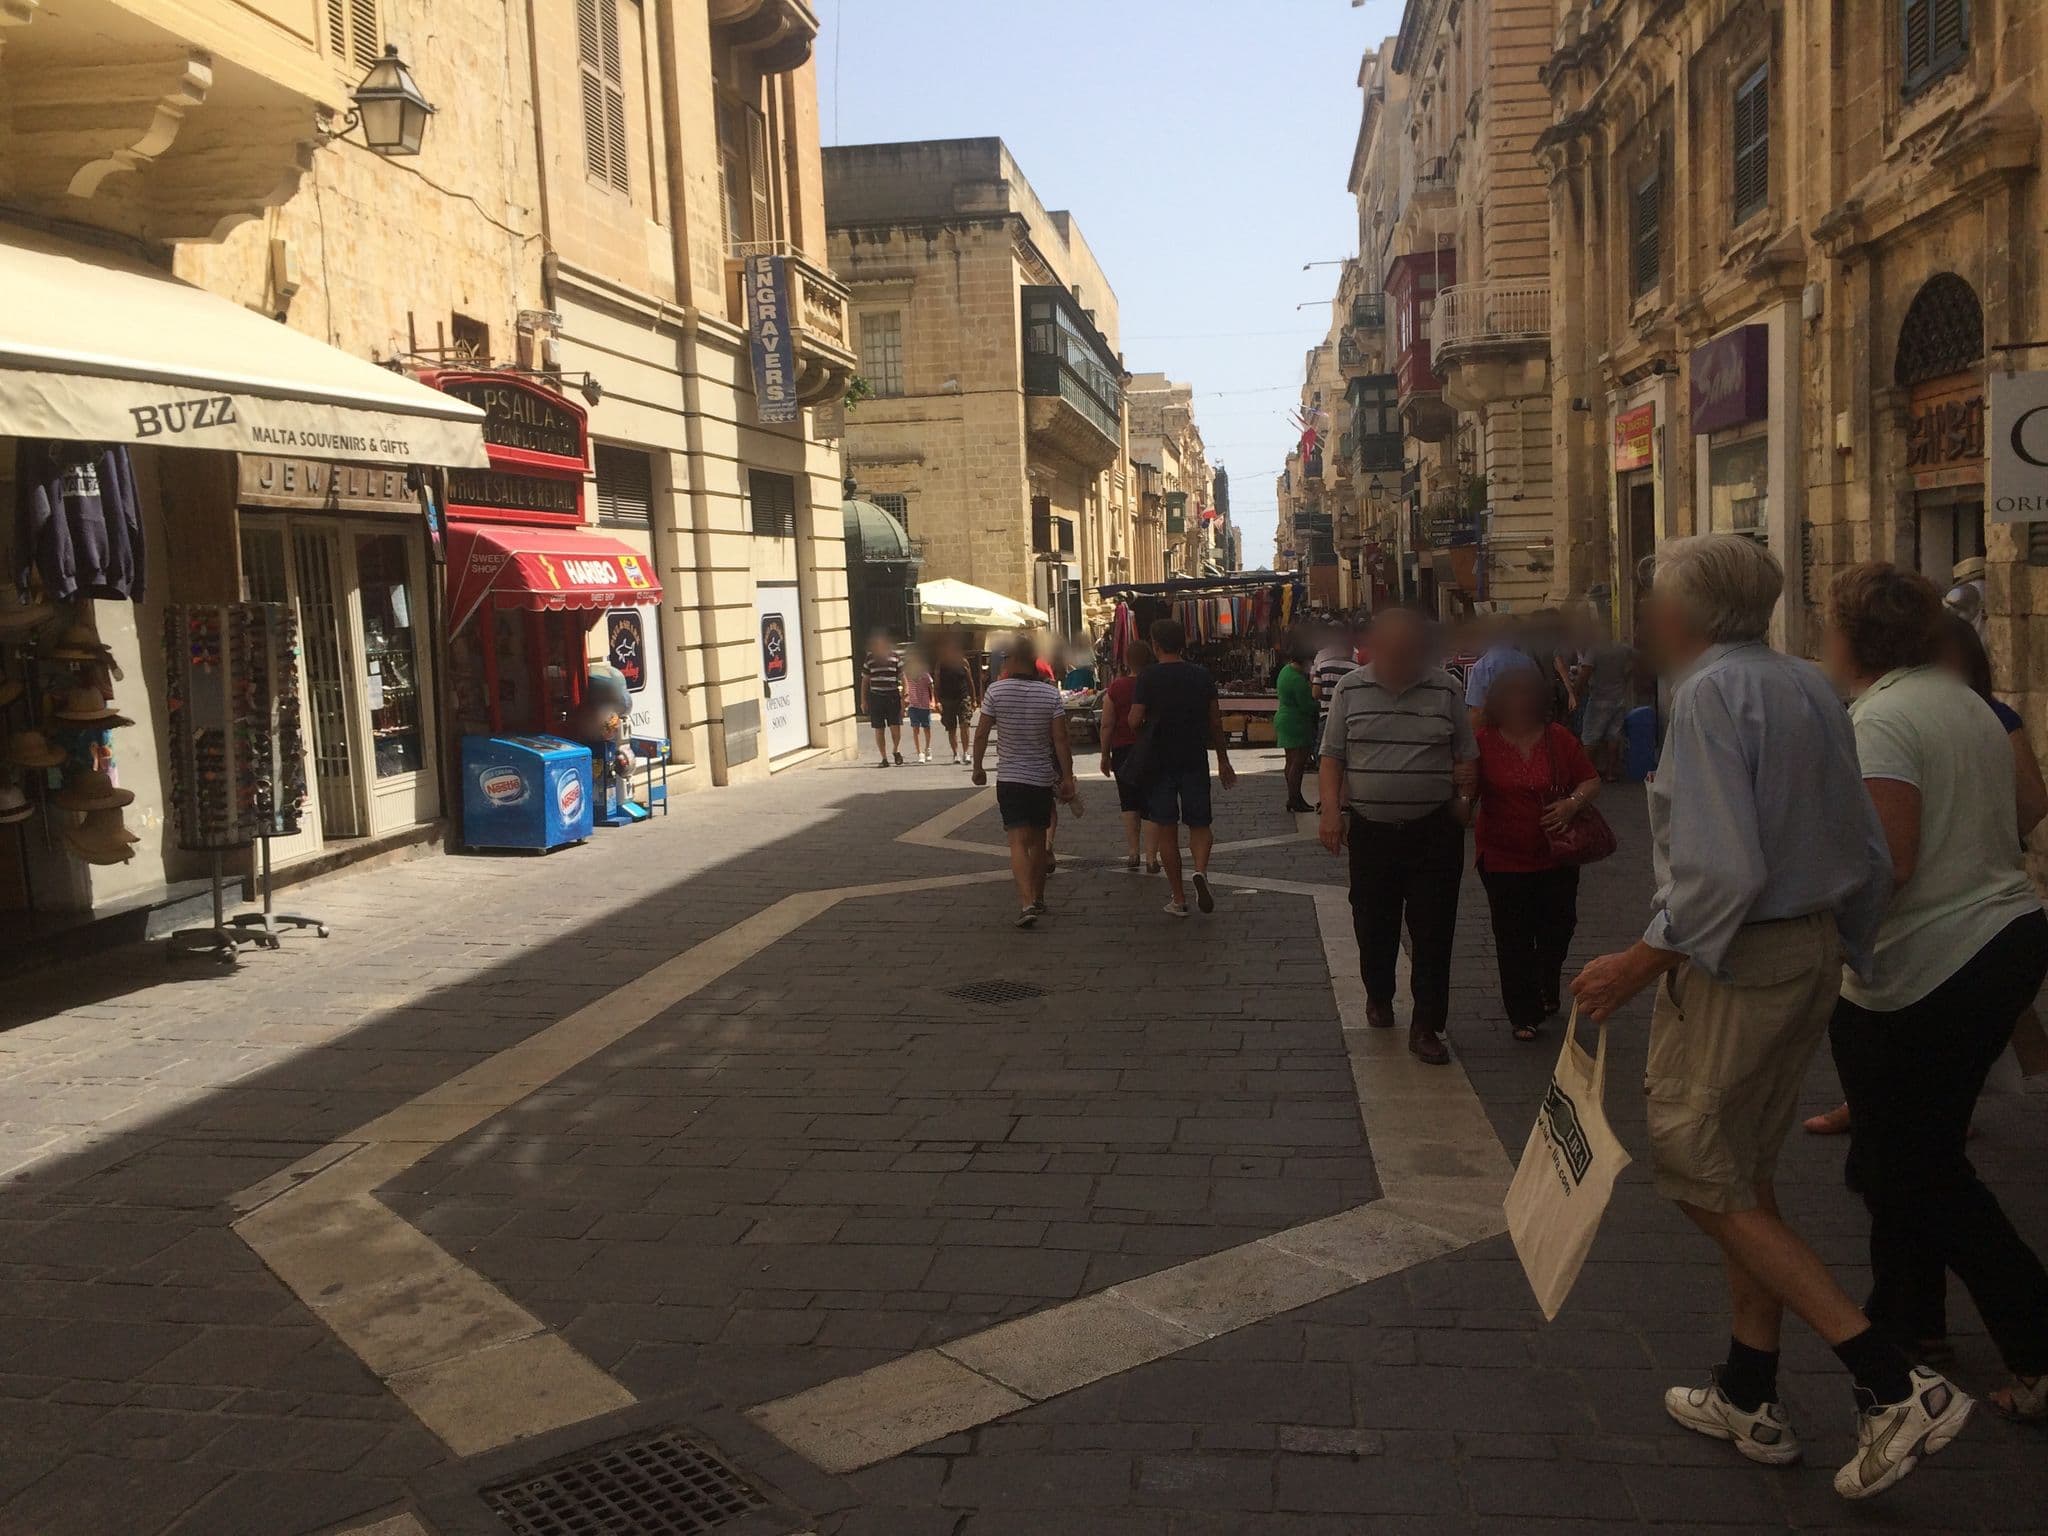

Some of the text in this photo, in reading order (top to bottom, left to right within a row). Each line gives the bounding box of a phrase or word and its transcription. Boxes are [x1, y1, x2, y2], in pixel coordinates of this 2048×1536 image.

[756, 257, 785, 401] ENGRAVERS
[129, 396, 237, 438] BUZZ
[252, 426, 410, 455] MALTA SOUVENIRS & GIFTS
[259, 461, 411, 500] JEWELLER
[1996, 495, 2048, 512] ORI
[471, 553, 506, 564] SWEET
[471, 564, 499, 574] SHOP
[562, 559, 619, 585] HARIBO
[629, 710, 650, 727] NING
